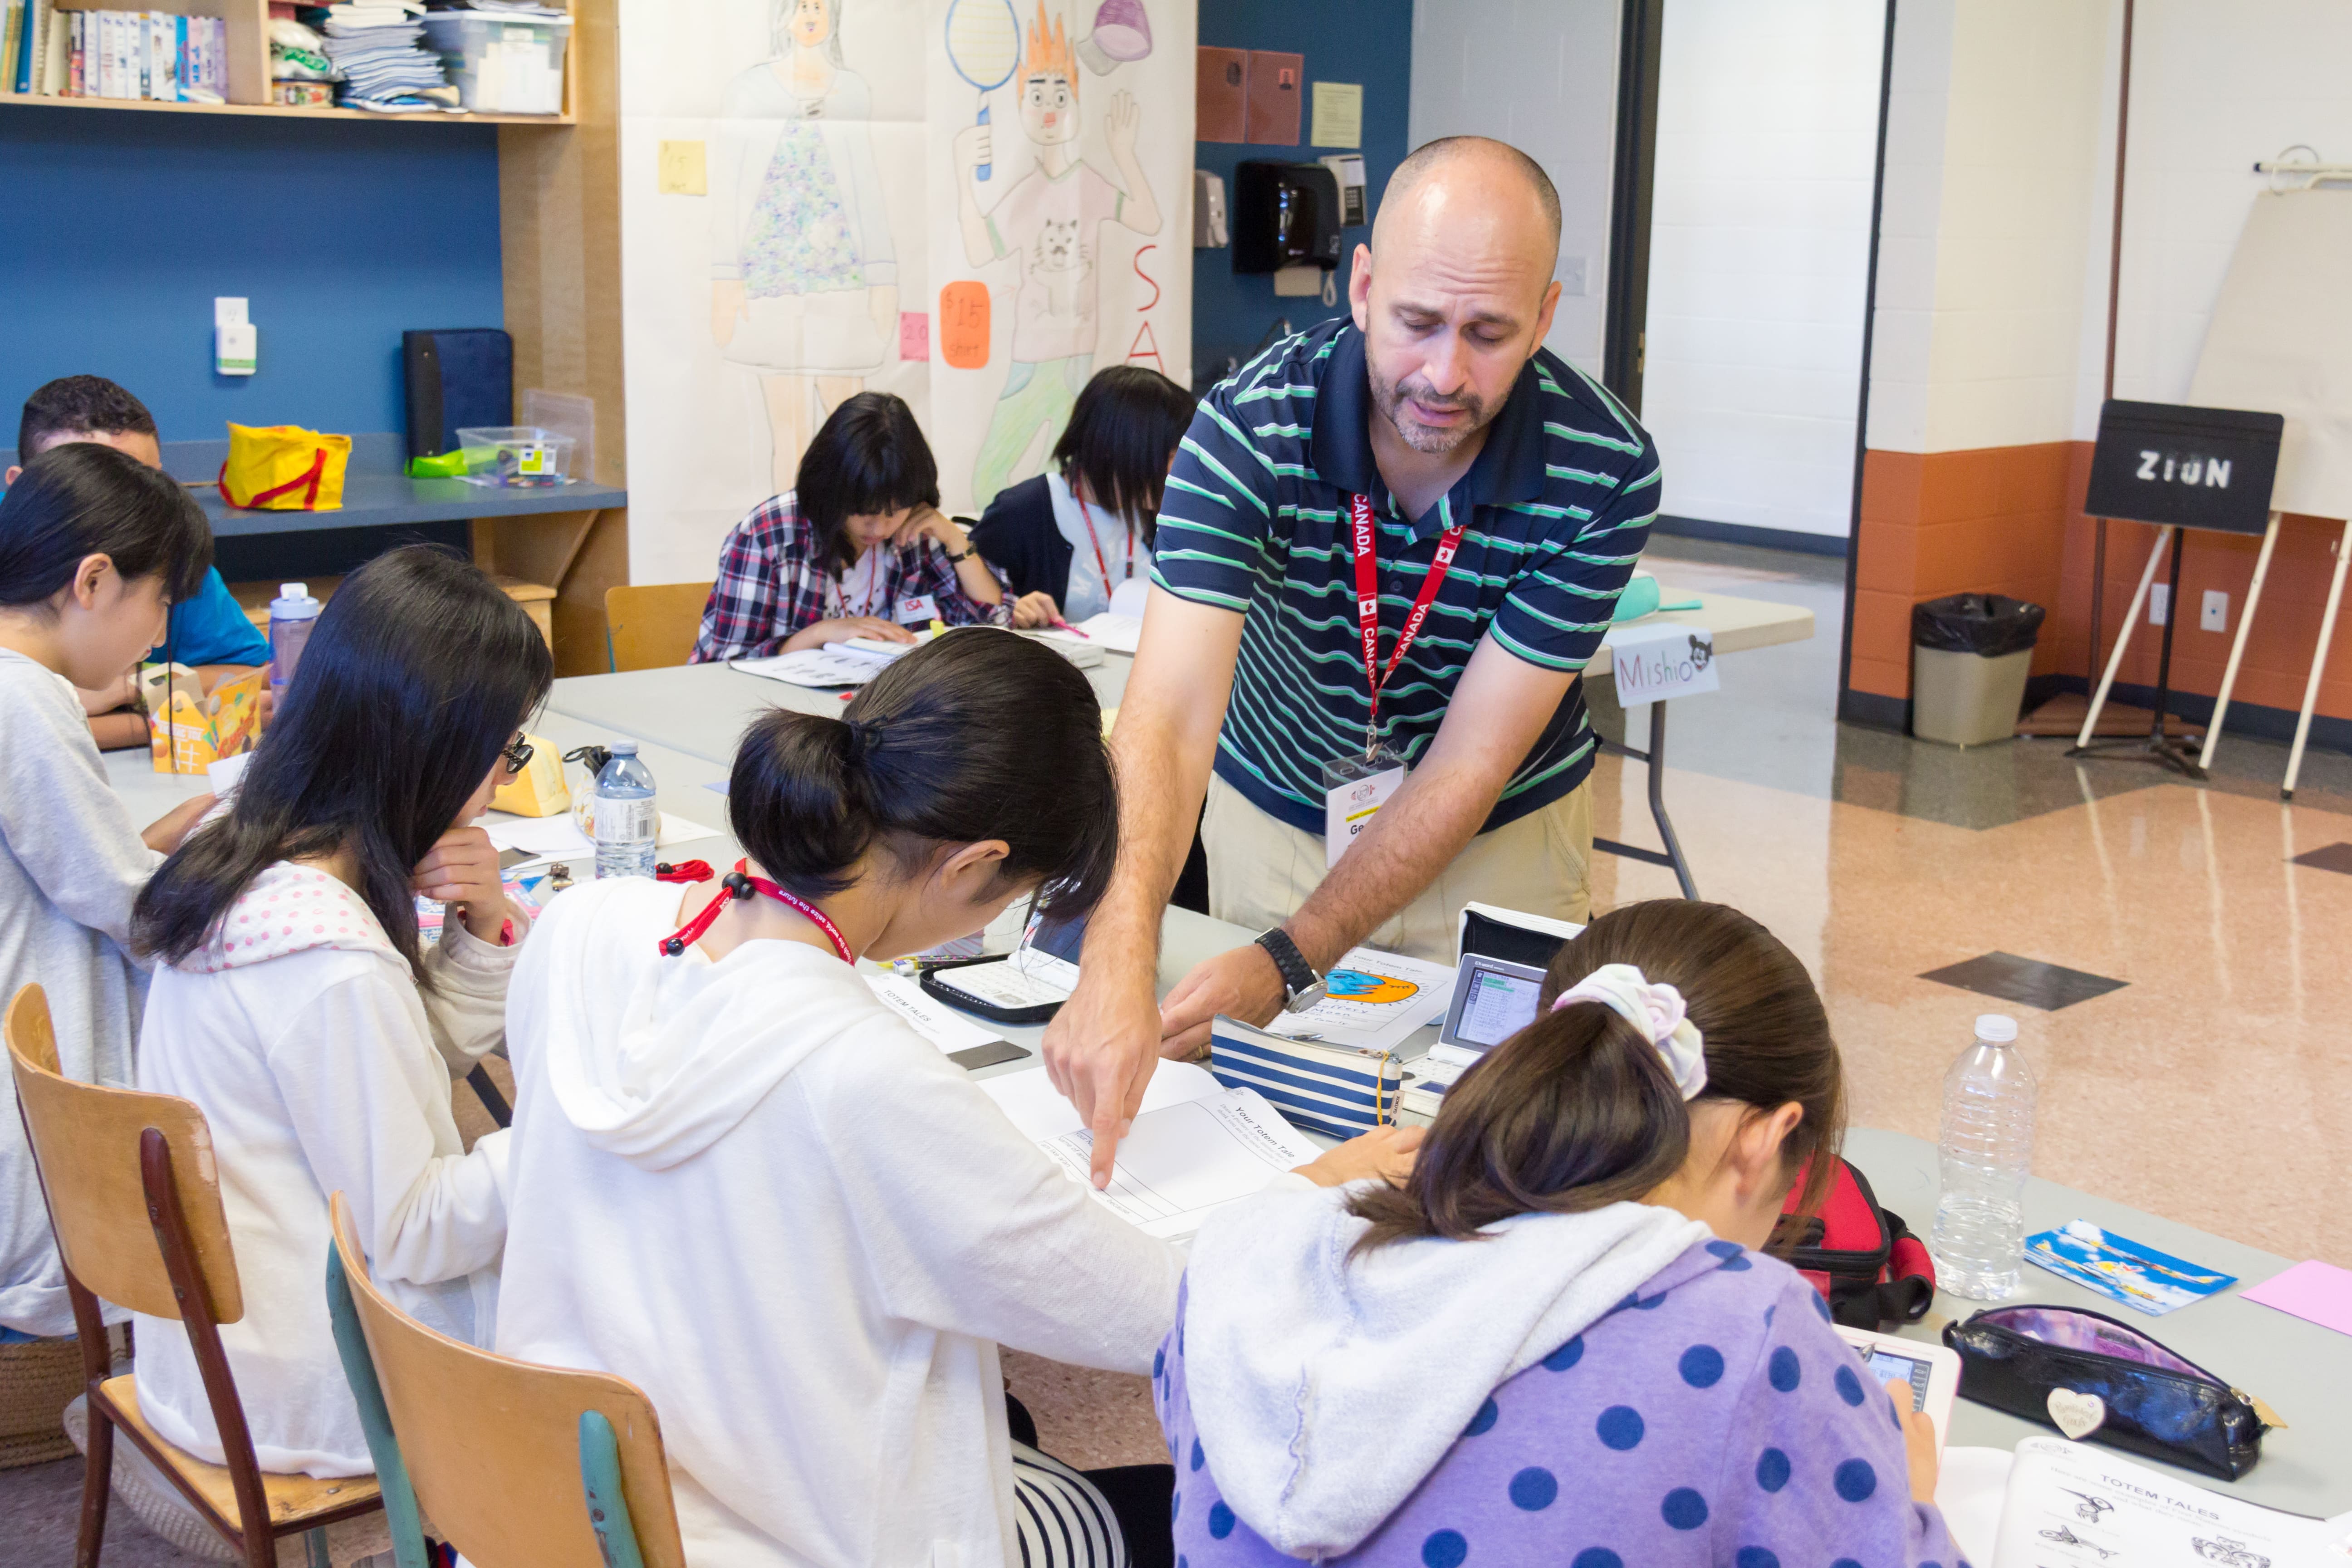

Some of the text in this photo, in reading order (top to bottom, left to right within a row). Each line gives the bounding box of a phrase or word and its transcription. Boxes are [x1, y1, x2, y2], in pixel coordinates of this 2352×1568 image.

[2136, 450, 2232, 489] ZION
[1353, 493, 1371, 557] CANADA
[1395, 604, 1430, 660] CANADA
[1350, 824, 1364, 835] Ge
[778, 890, 799, 905] future
[799, 901, 810, 912] the
[810, 909, 826, 923] seize
[884, 990, 931, 1022] TOTEM TALES
[1235, 1107, 1294, 1158] Your Totem Tale
[1076, 1151, 1091, 1167] anim
[2100, 1474, 2220, 1520] TOTEM TALES
